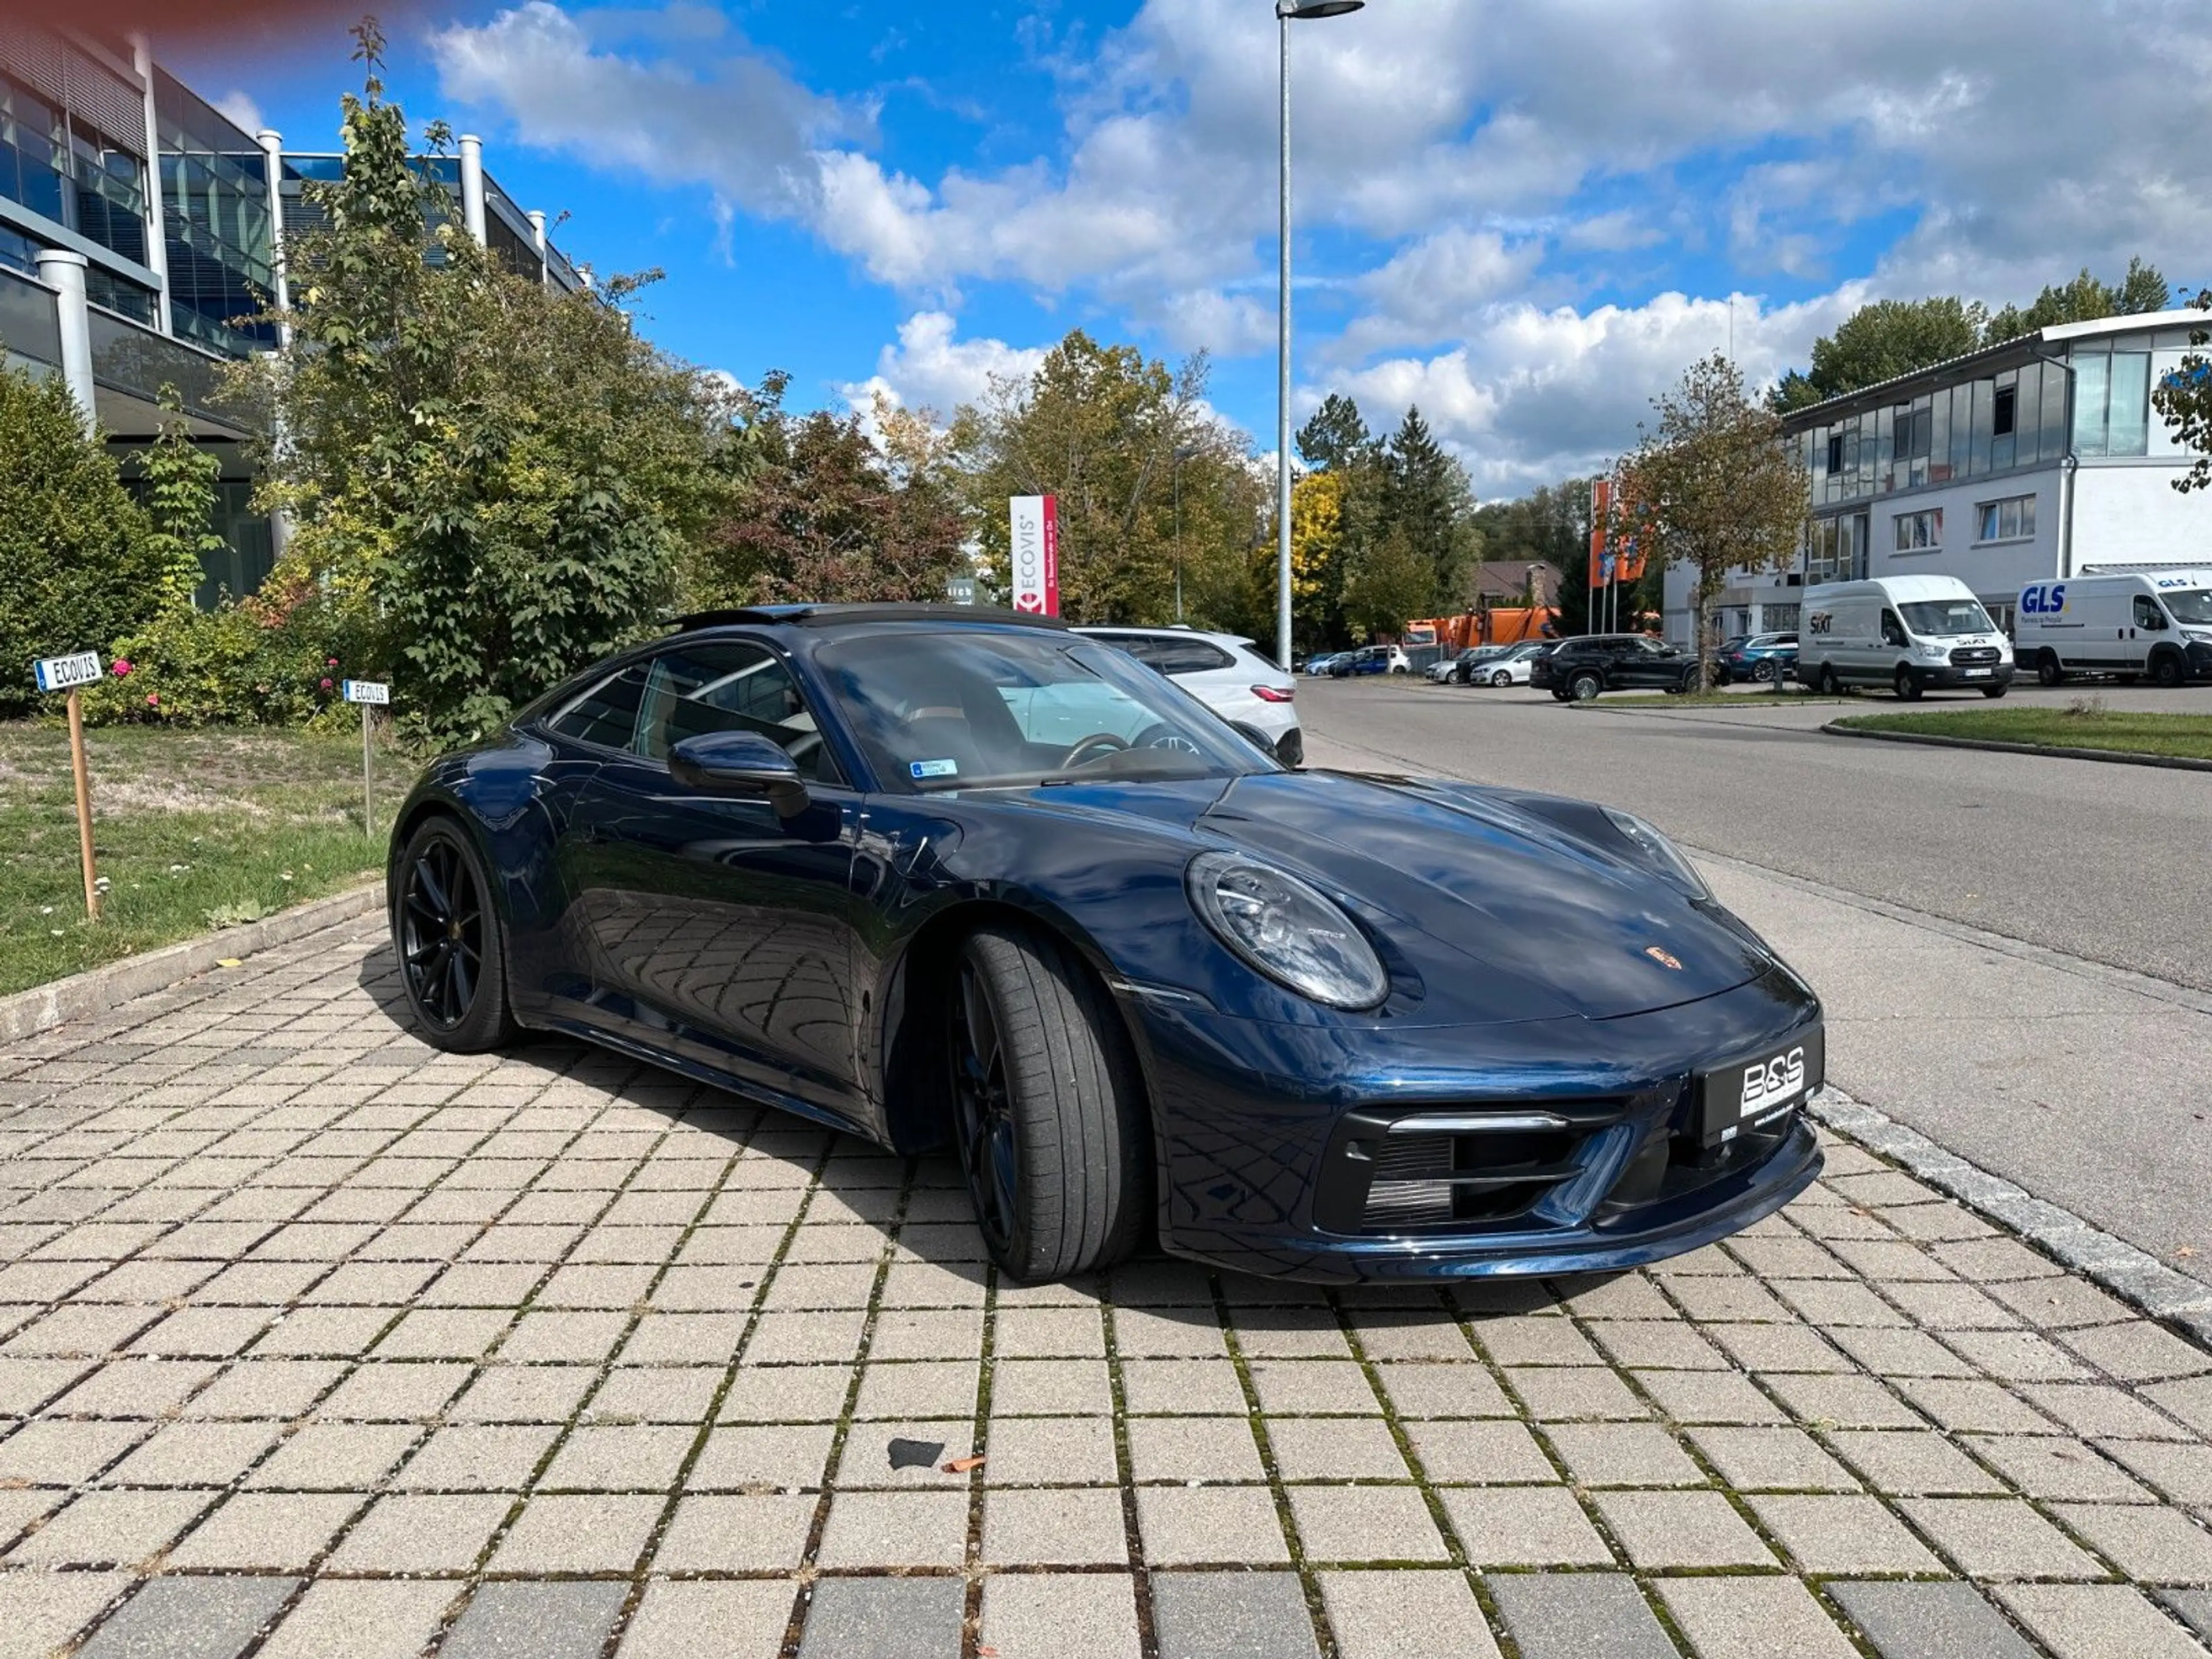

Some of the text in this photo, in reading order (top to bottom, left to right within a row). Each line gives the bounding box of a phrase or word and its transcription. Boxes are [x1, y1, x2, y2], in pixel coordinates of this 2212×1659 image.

[1020, 520, 1036, 588] ECOVIS
[2159, 579, 2187, 588] GLS
[2022, 585, 2066, 613] GLS
[54, 656, 96, 684] ECOVIS
[355, 684, 384, 700] ECOVIS
